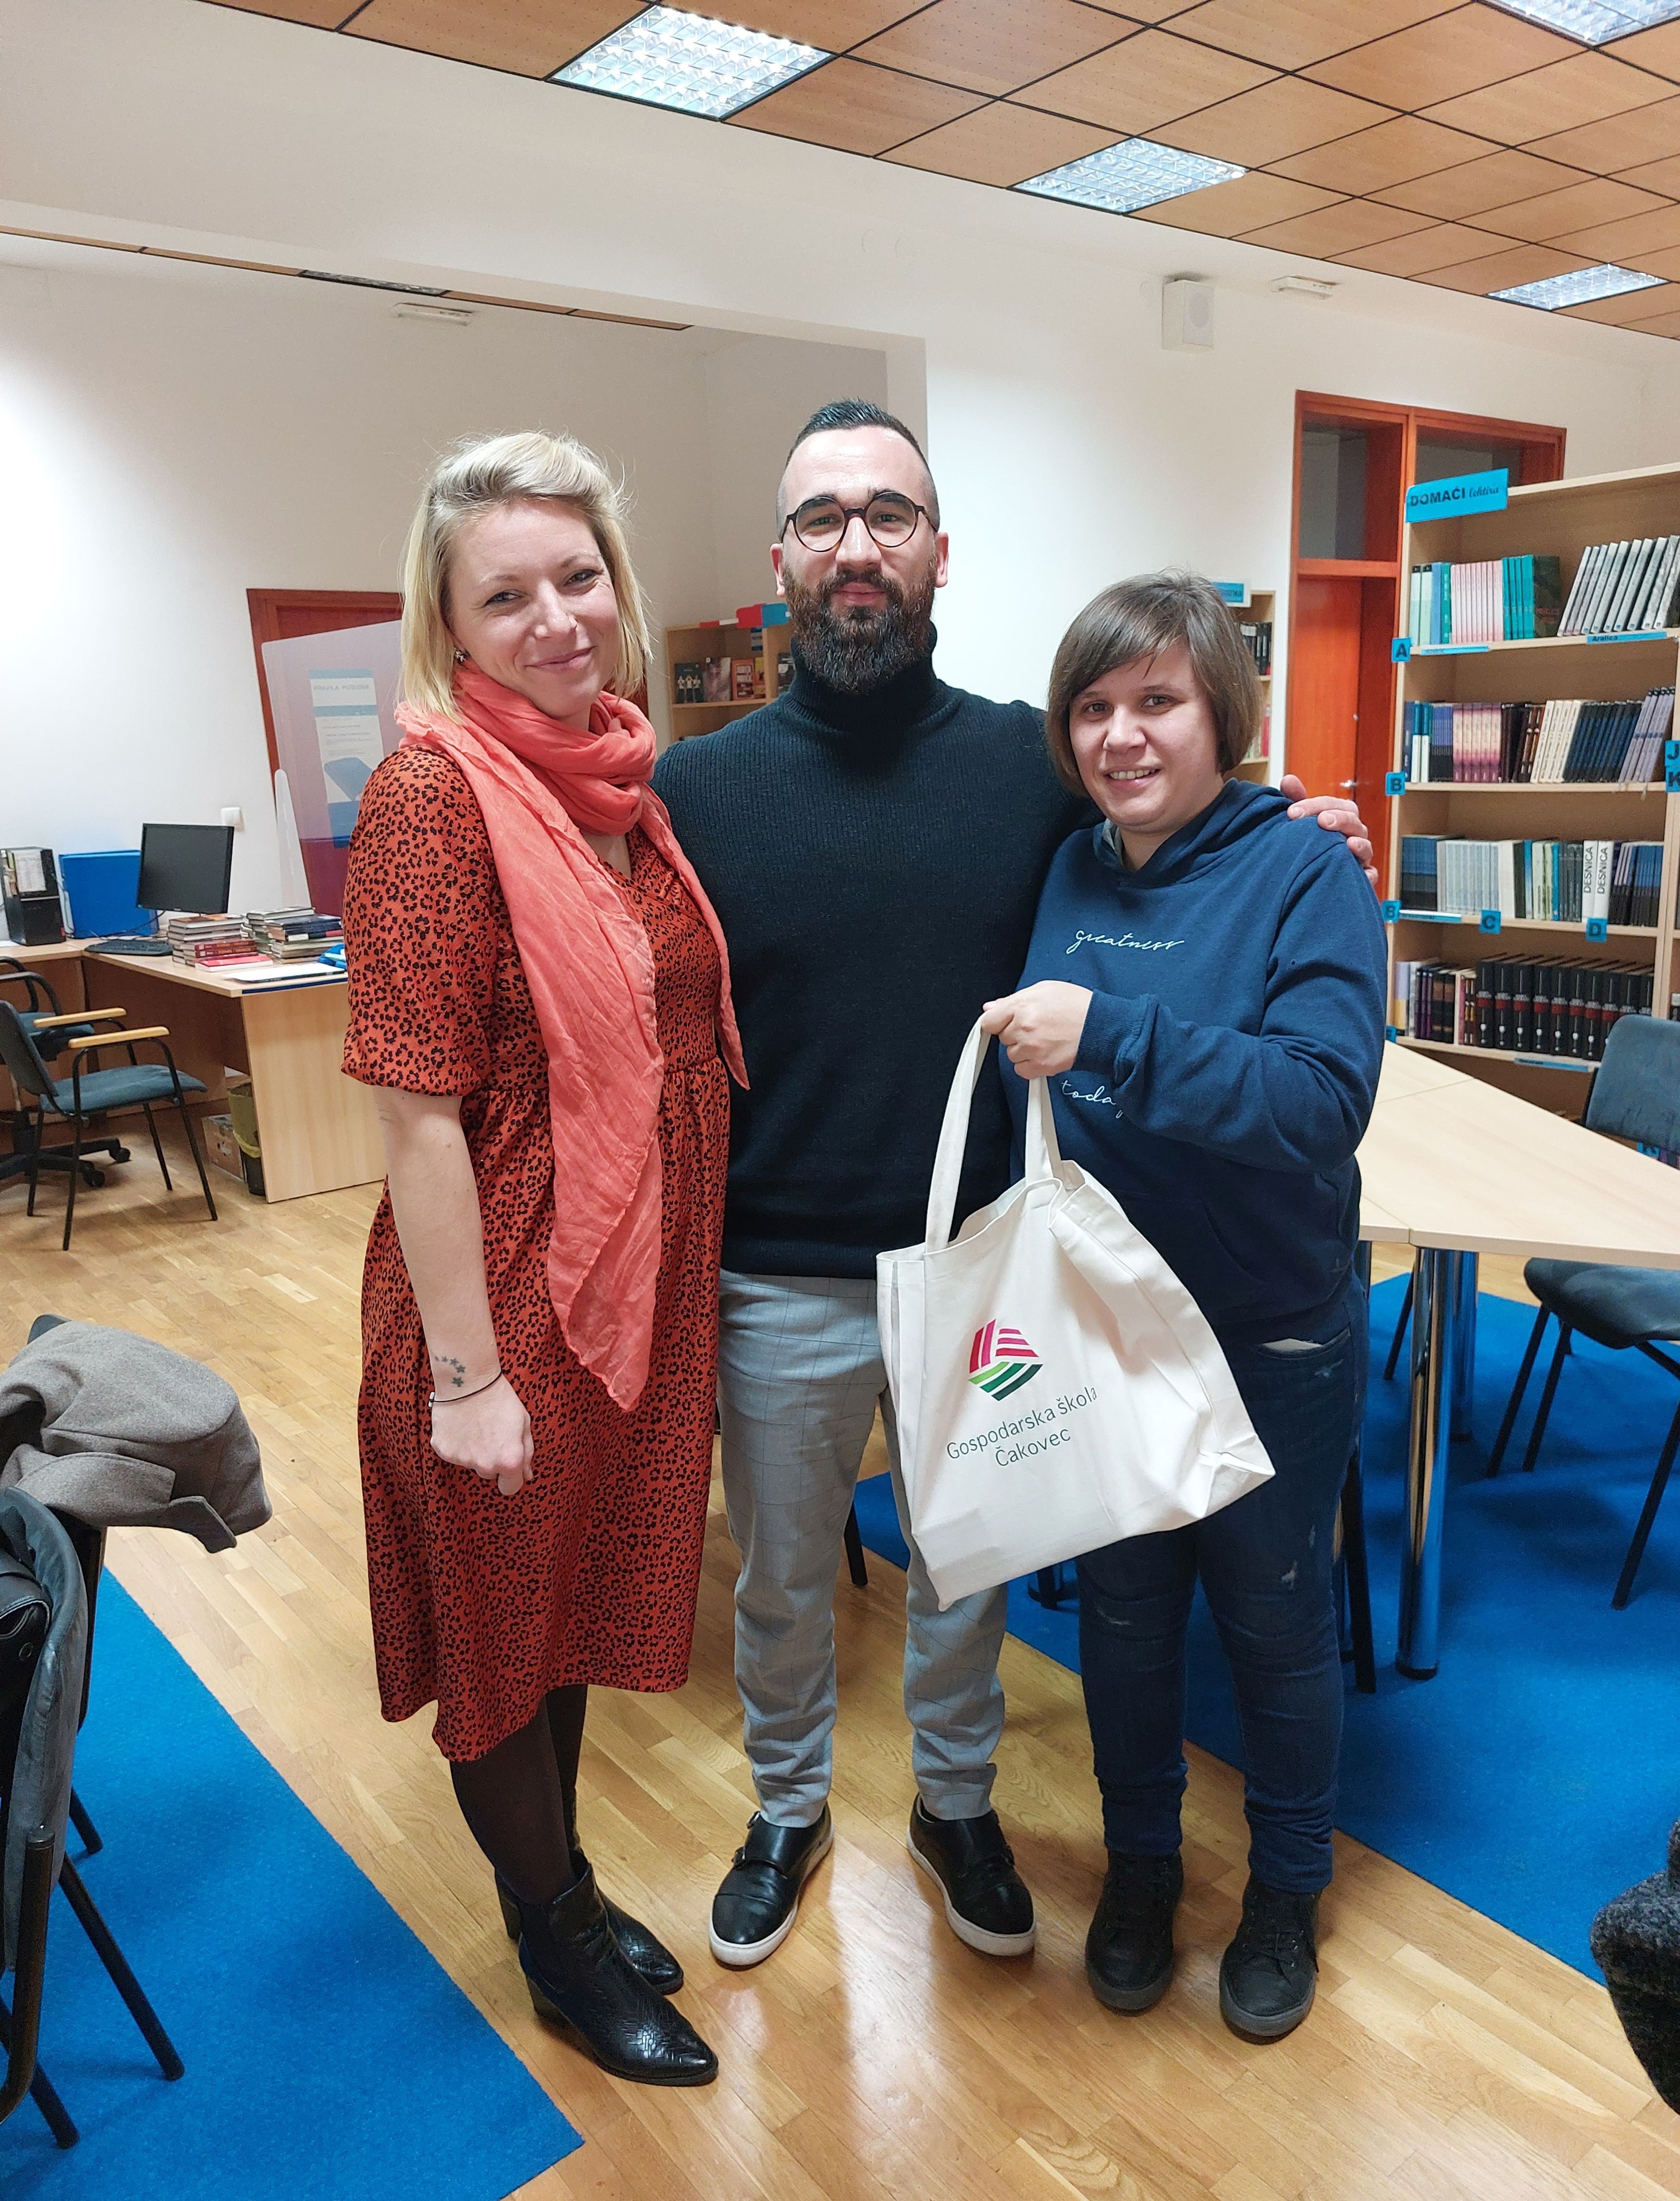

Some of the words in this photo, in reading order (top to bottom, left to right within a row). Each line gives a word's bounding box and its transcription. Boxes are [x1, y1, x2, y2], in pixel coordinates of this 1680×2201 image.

[1469, 485, 1499, 498] lektira
[1395, 643, 1407, 658] A
[1667, 743, 1680, 760] J
[1391, 778, 1402, 791] B
[1668, 771, 1680, 786] K
[1584, 846, 1593, 893] DESNICA
[1597, 847, 1608, 894] DESNICA
[1482, 914, 1496, 929] C
[1589, 923, 1602, 937] D
[1066, 929, 1185, 955] greatness
[946, 1408, 1055, 1459] Gospodarska
[995, 1426, 1071, 1467] Čakovec
